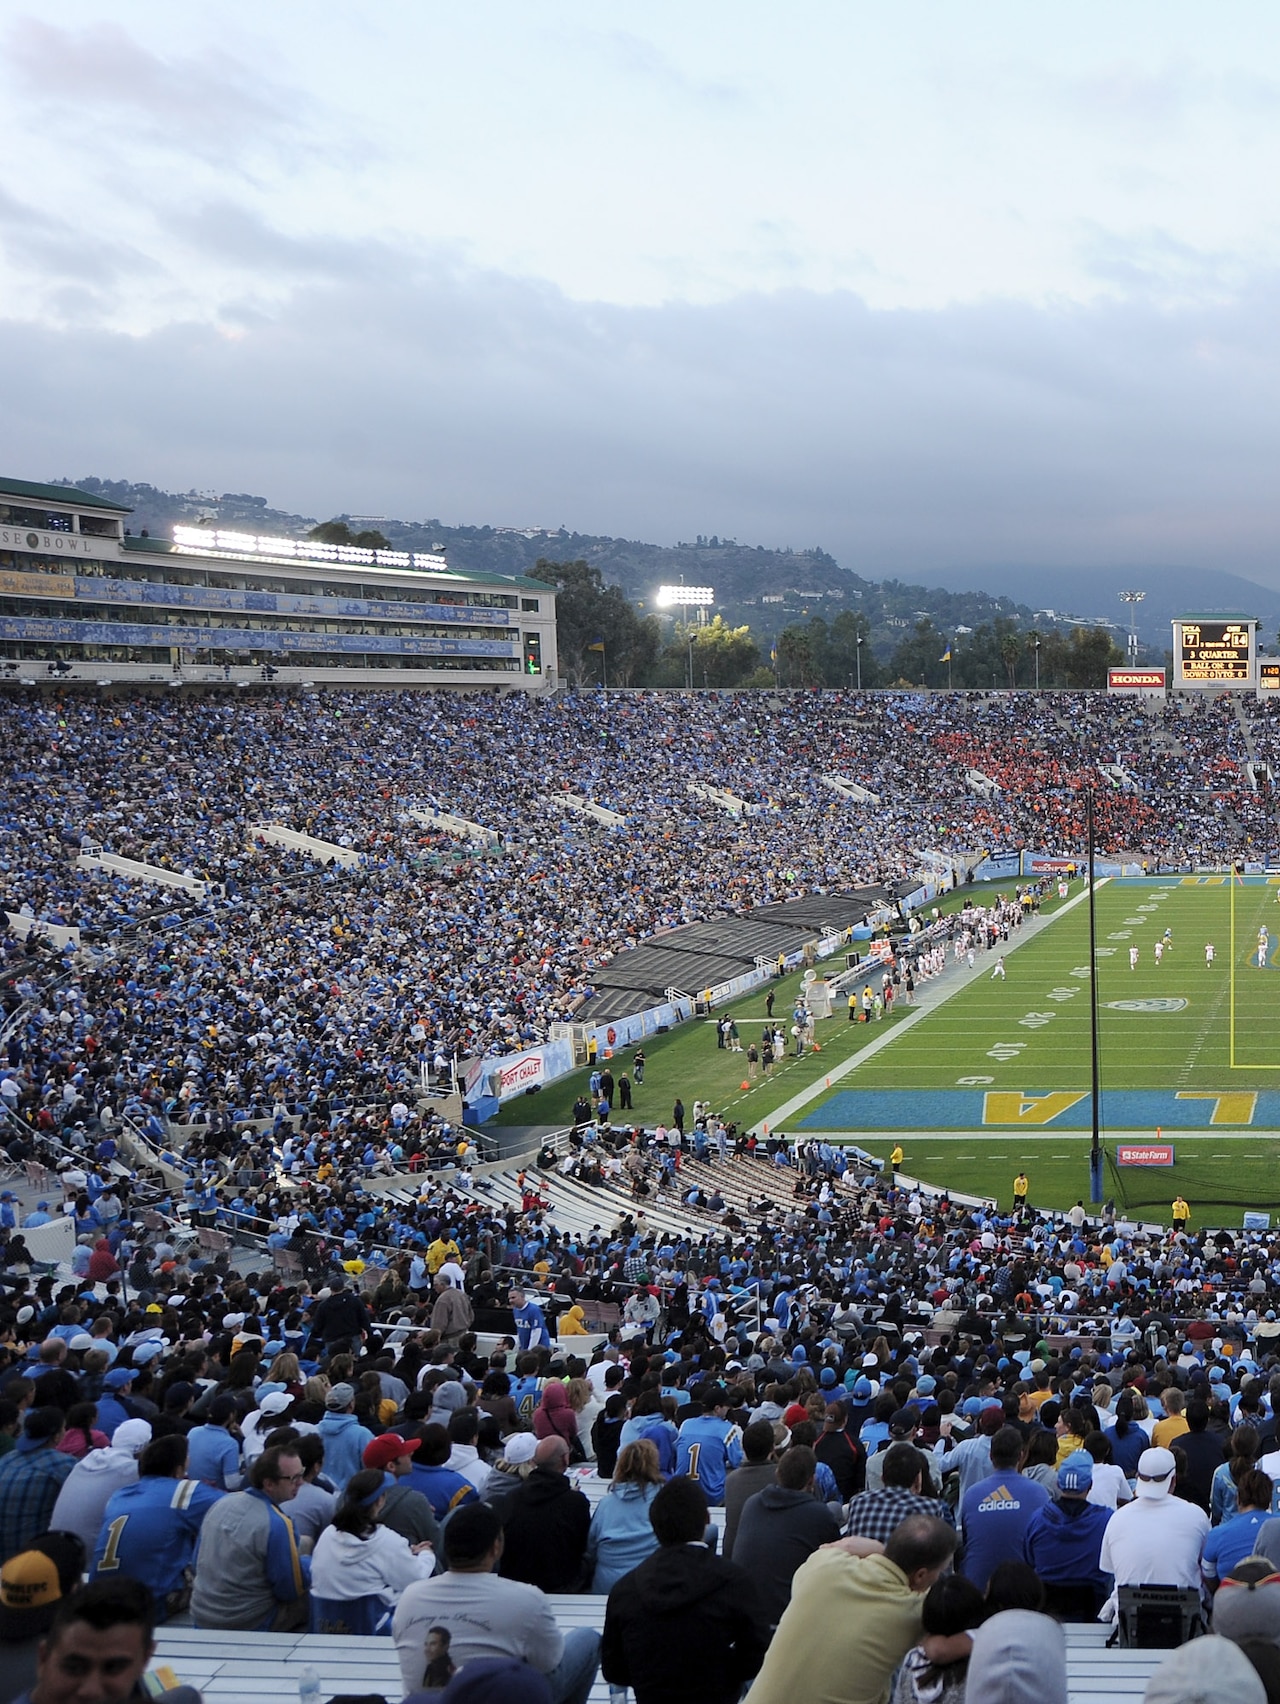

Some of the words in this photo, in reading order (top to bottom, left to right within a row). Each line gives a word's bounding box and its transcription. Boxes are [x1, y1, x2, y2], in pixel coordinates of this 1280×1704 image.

[43, 536, 92, 553] BOWL
[1187, 635, 1195, 645] 7
[1234, 635, 1246, 645] 14
[1190, 651, 1195, 659] 3
[1199, 651, 1239, 660] QUARTER
[1112, 676, 1162, 684] HONDA
[1018, 1012, 1057, 1025] 20
[986, 1042, 1028, 1057] 10
[519, 1061, 542, 1080] CHALET
[1131, 1151, 1149, 1160] State
[1149, 1151, 1168, 1160] Farm
[686, 1442, 701, 1481] 1
[978, 1499, 1021, 1513] adidas
[97, 1514, 130, 1572] 1
[1132, 1591, 1188, 1602] RAIDERS
